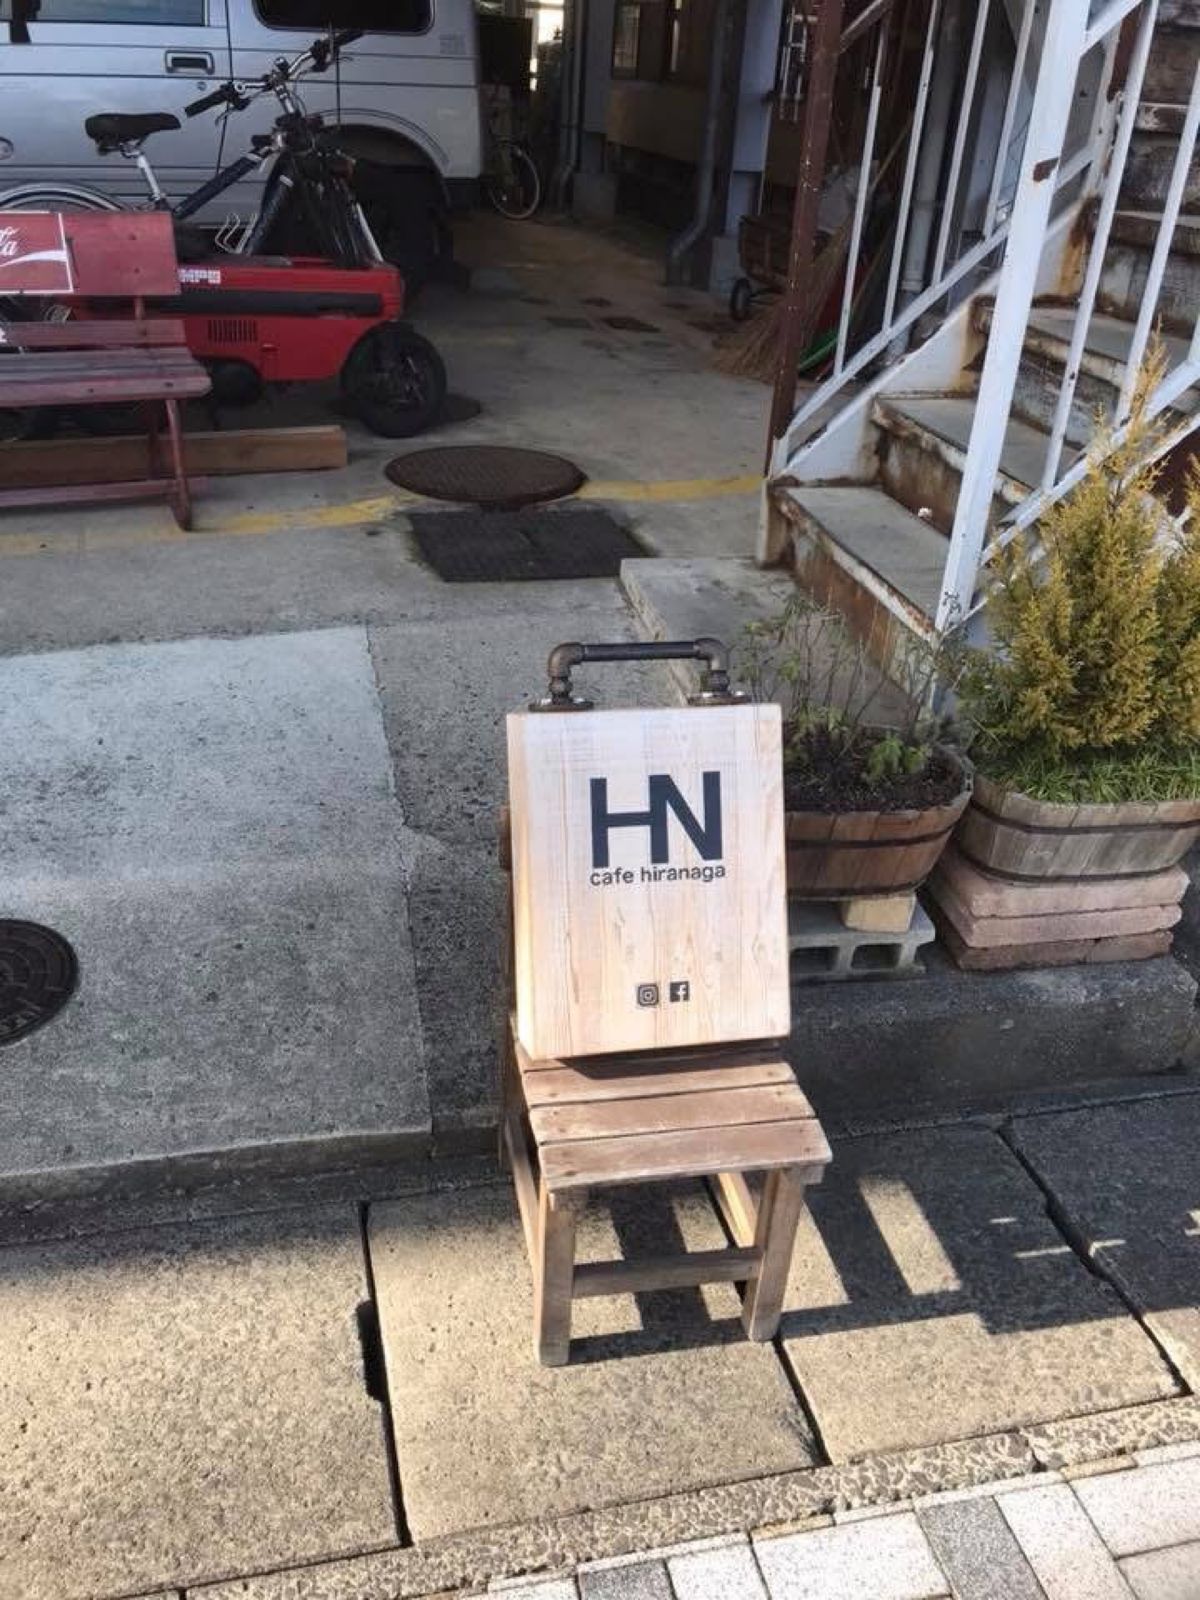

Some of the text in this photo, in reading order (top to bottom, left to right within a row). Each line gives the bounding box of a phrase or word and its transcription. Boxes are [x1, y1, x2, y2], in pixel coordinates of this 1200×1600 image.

[590, 771, 722, 868] HN
[589, 864, 726, 886] cafe hiranaga
